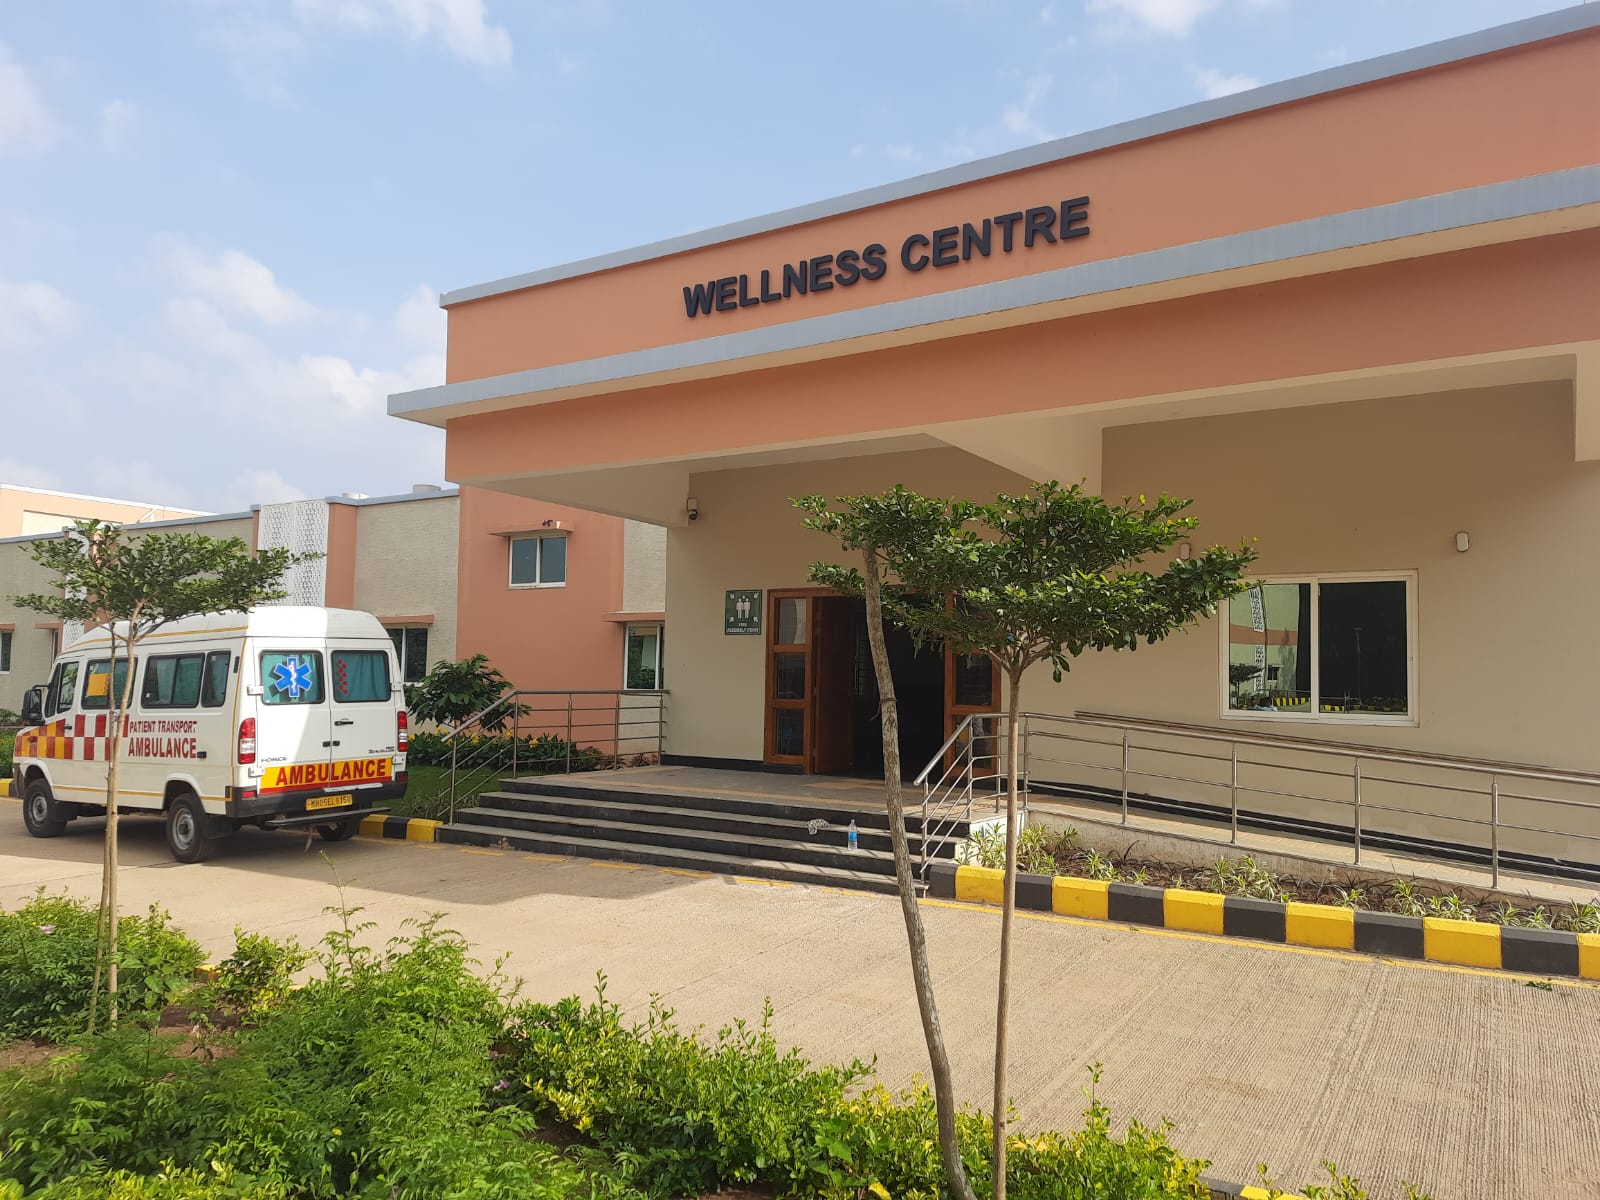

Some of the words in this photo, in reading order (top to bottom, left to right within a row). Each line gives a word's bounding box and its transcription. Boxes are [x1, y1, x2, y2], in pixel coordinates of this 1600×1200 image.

[683, 243, 887, 318] WELLNESS
[900, 196, 1090, 272] CENTRE
[129, 720, 156, 733] PATIENT
[157, 720, 197, 733] TRANSPORT
[128, 737, 197, 758] AMBULANCE
[275, 758, 386, 786] AMBULANCE
